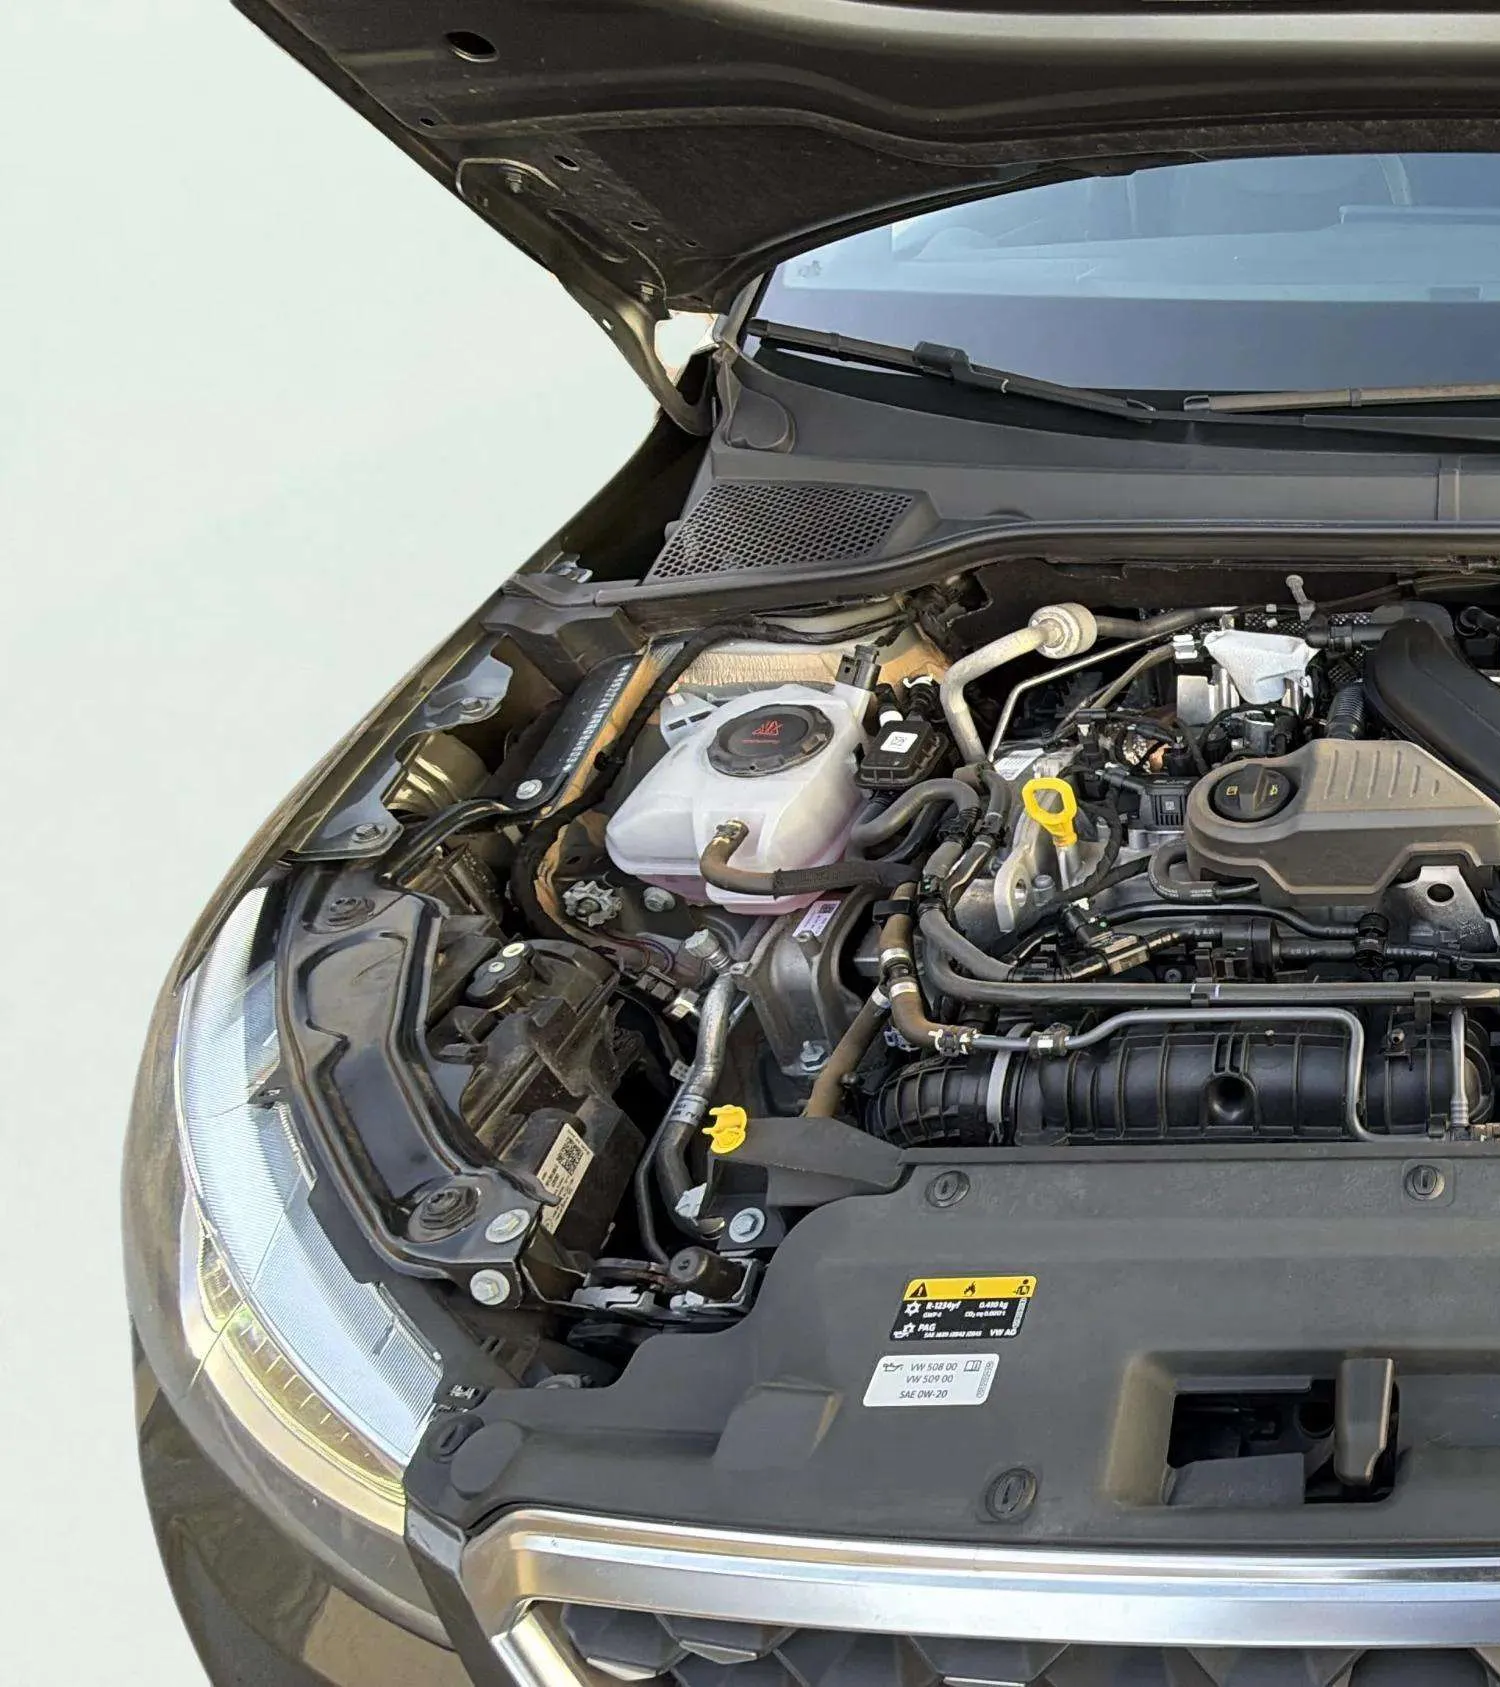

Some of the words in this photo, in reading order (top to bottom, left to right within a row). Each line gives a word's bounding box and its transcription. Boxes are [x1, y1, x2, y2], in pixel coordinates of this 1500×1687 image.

[925, 1300, 962, 1311] R-1234yf
[917, 1323, 937, 1332] PAG
[989, 1328, 1004, 1337] VW
[910, 1362, 926, 1372] VW
[927, 1362, 943, 1372] 508
[945, 1362, 958, 1371] 00
[906, 1375, 922, 1384] VW
[922, 1375, 940, 1384] 509
[941, 1374, 954, 1383] 00
[899, 1390, 917, 1399] SAE
[917, 1389, 948, 1399] 0W-20
